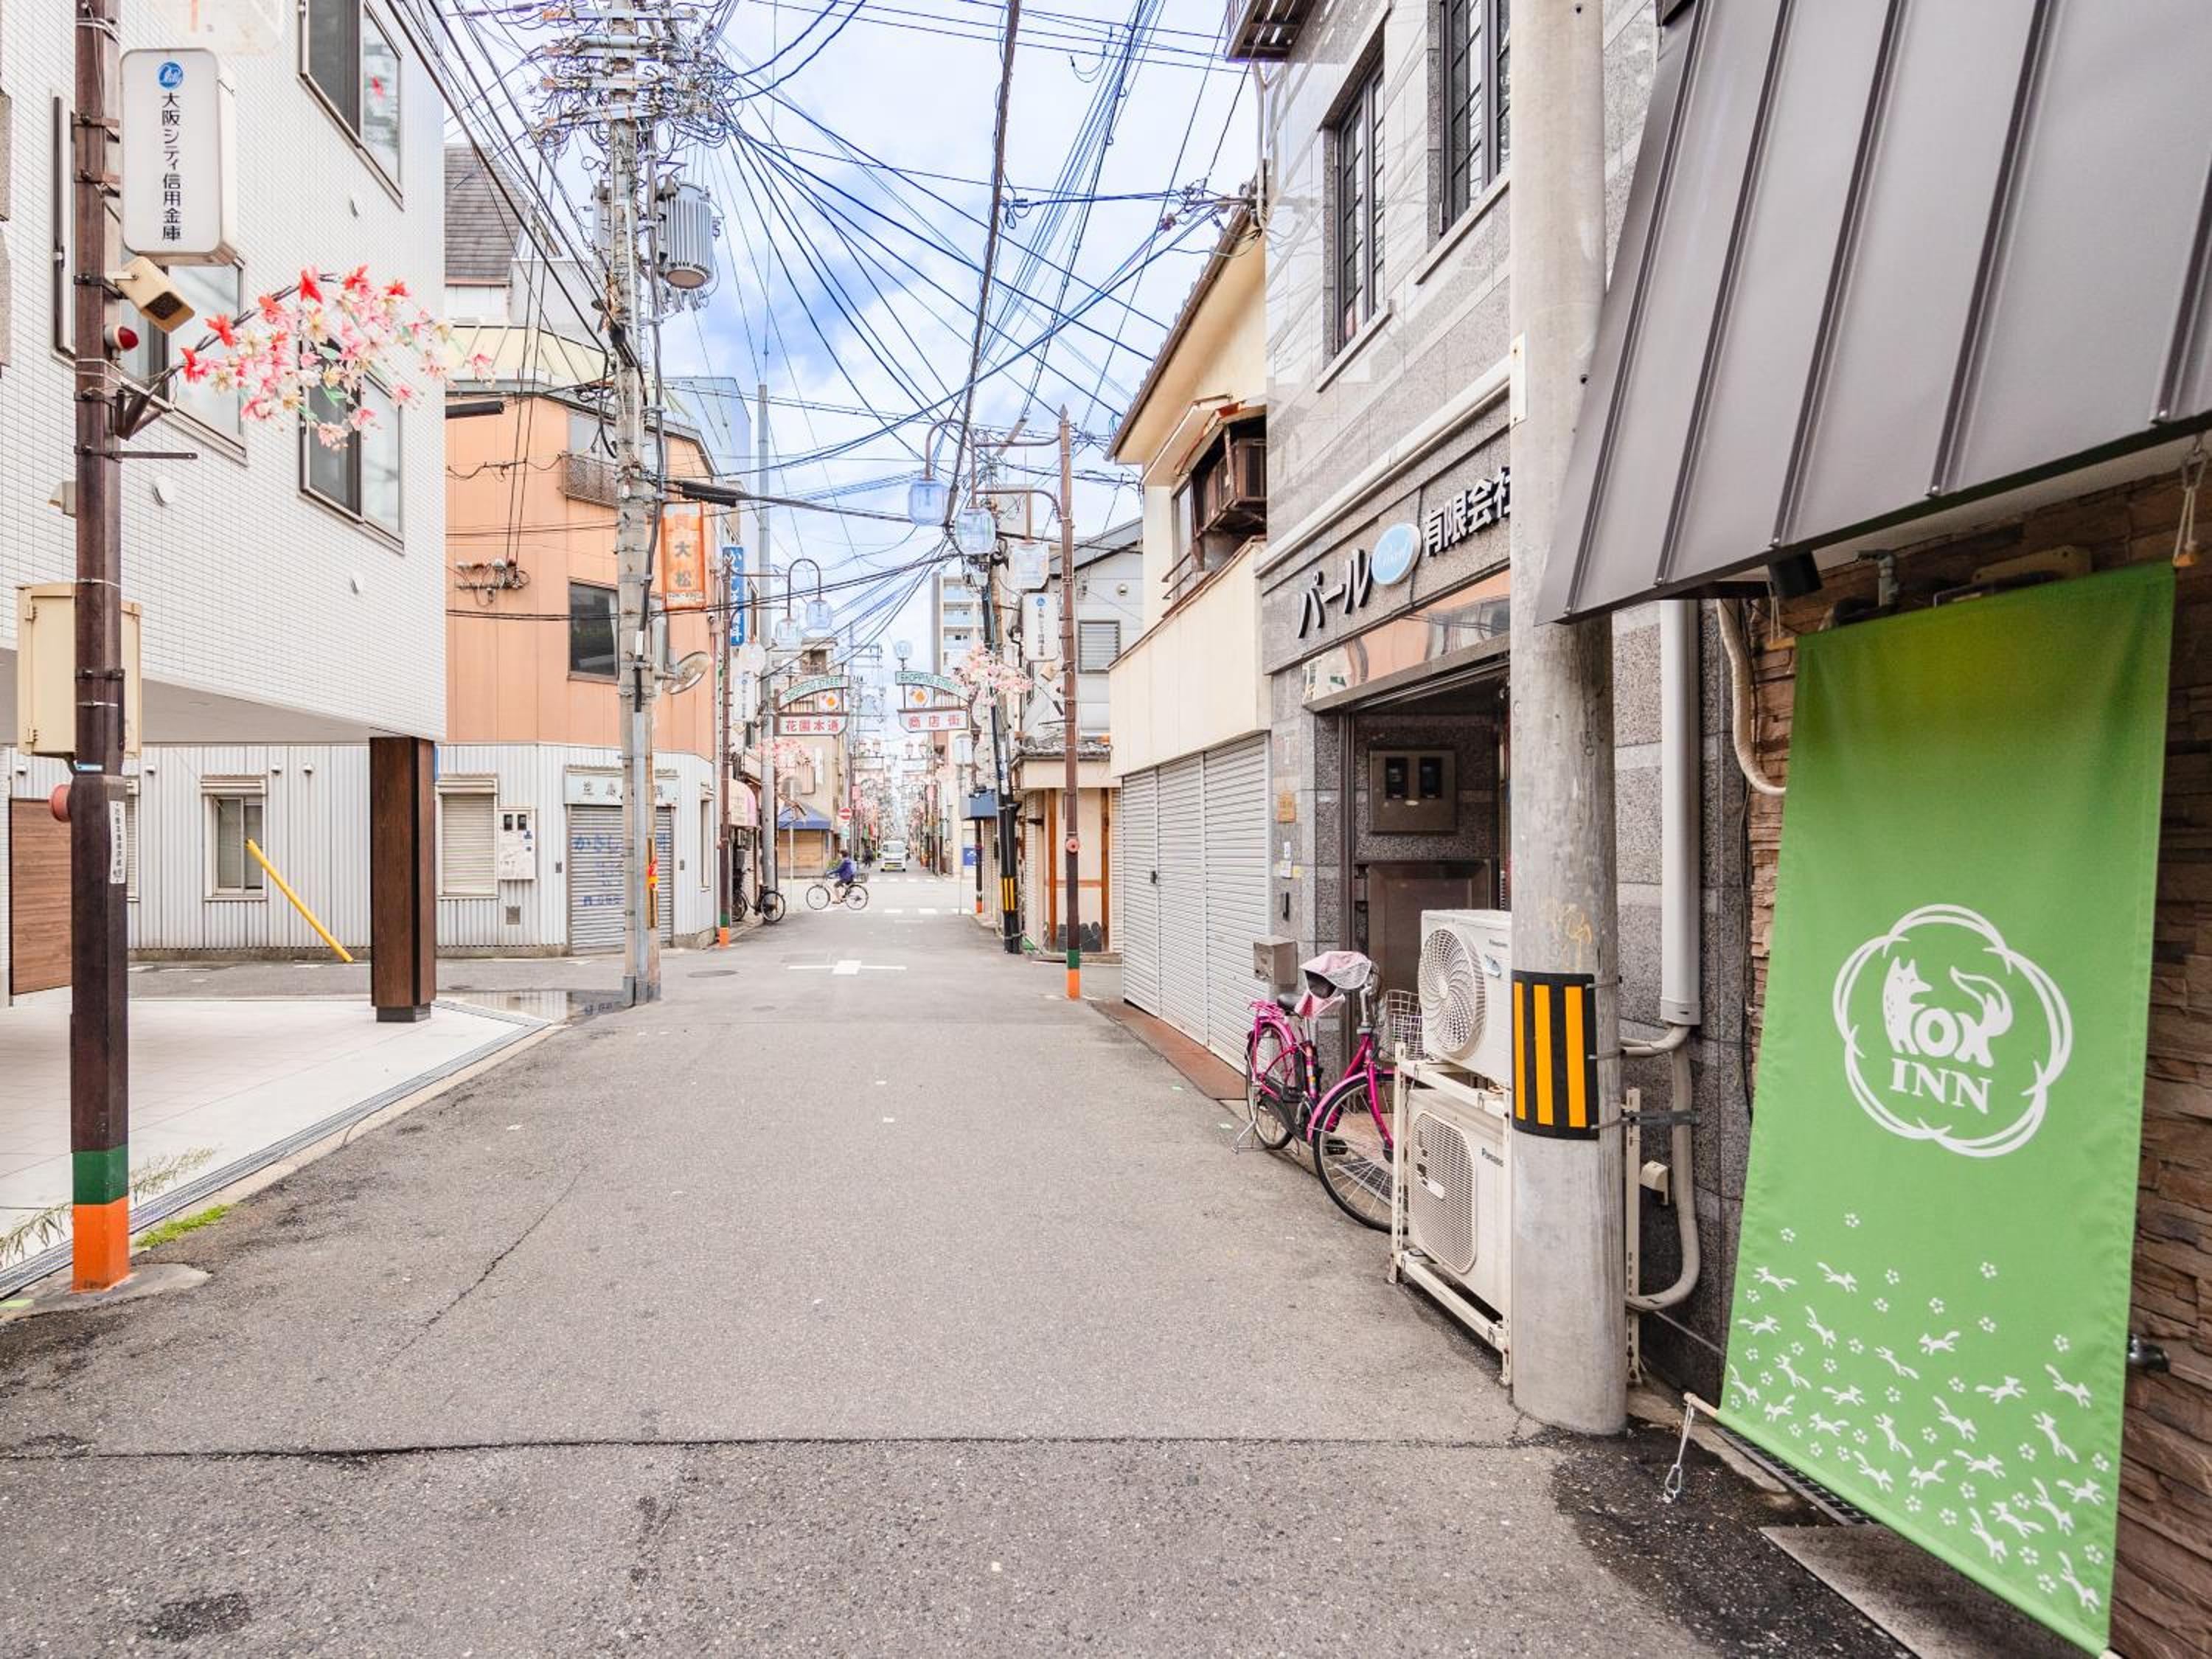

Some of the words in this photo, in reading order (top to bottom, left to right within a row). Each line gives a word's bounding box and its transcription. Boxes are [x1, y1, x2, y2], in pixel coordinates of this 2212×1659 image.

[161, 93, 181, 241] 大阪シティ信用金庫
[1298, 549, 1373, 639] パール
[786, 720, 838, 731] 花園本通
[908, 715, 961, 728] 商店街
[1890, 1058, 1992, 1115] INN
